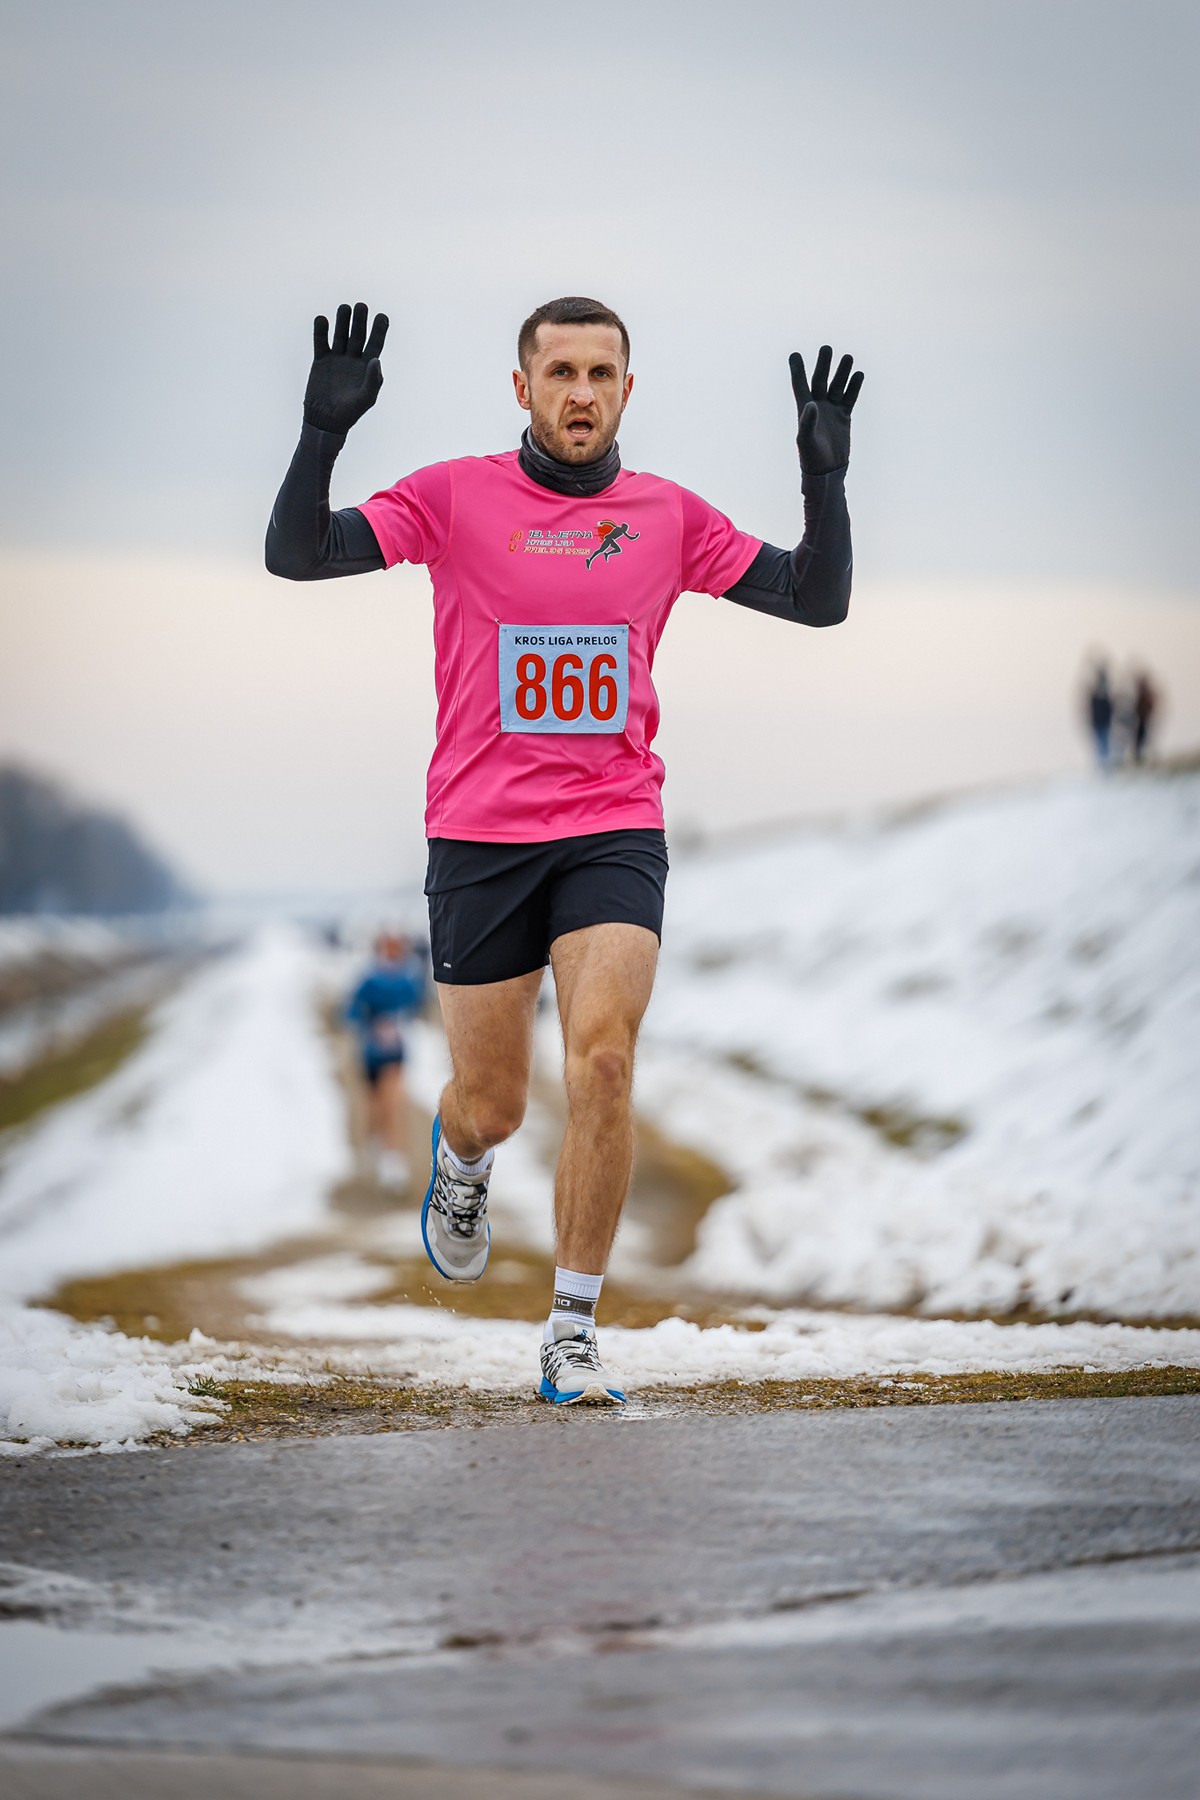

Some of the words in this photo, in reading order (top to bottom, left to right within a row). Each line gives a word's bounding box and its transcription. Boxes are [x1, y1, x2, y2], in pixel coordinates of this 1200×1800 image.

[546, 530, 593, 538] LJETNA
[515, 636, 545, 645] KROS
[548, 637, 574, 645] LIGA
[576, 636, 617, 645] PRELOG
[515, 653, 617, 721] 866
